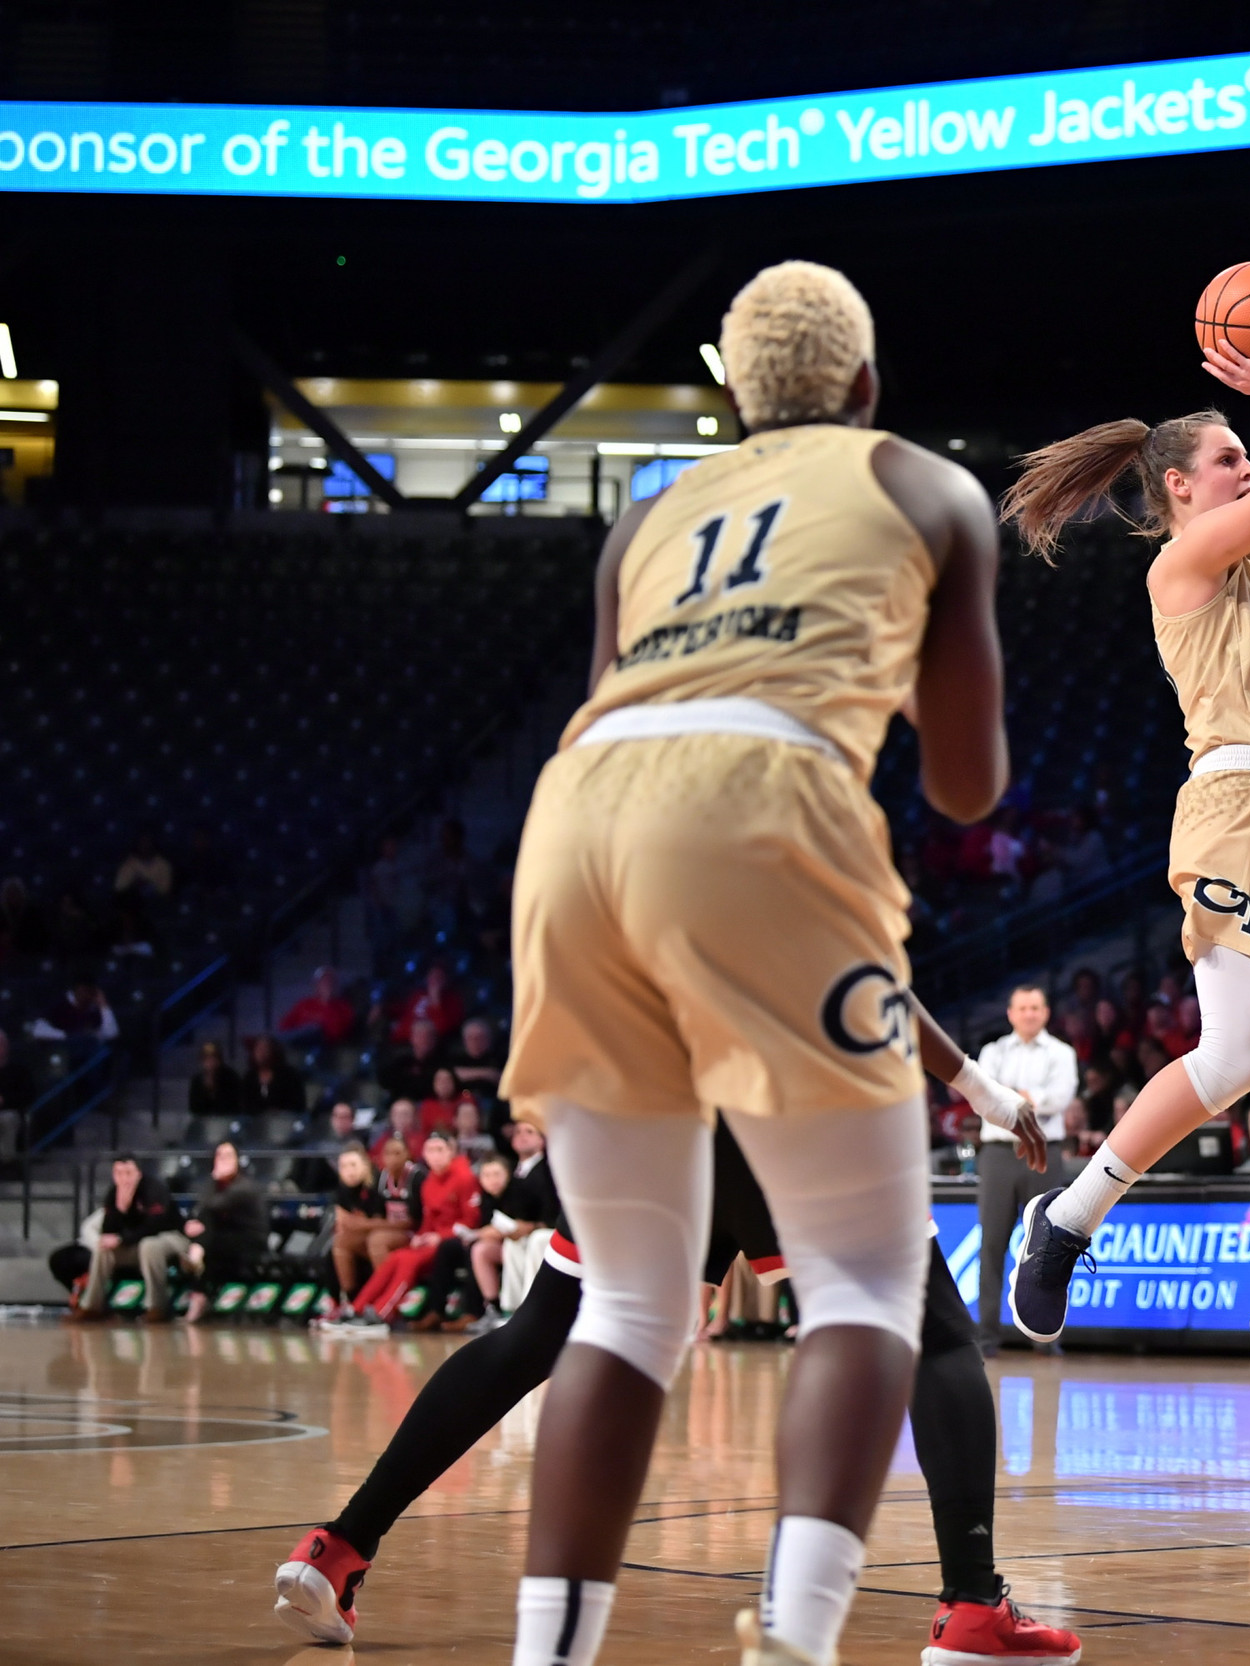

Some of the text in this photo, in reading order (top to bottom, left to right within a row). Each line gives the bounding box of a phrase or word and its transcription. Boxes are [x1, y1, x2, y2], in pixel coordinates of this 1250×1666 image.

[223, 119, 290, 175] of
[303, 122, 407, 179] the
[425, 127, 659, 198] Georgia
[836, 98, 1016, 163] Yellow
[674, 498, 784, 607] 11
[1069, 1278, 1238, 1310] DIT UNION
